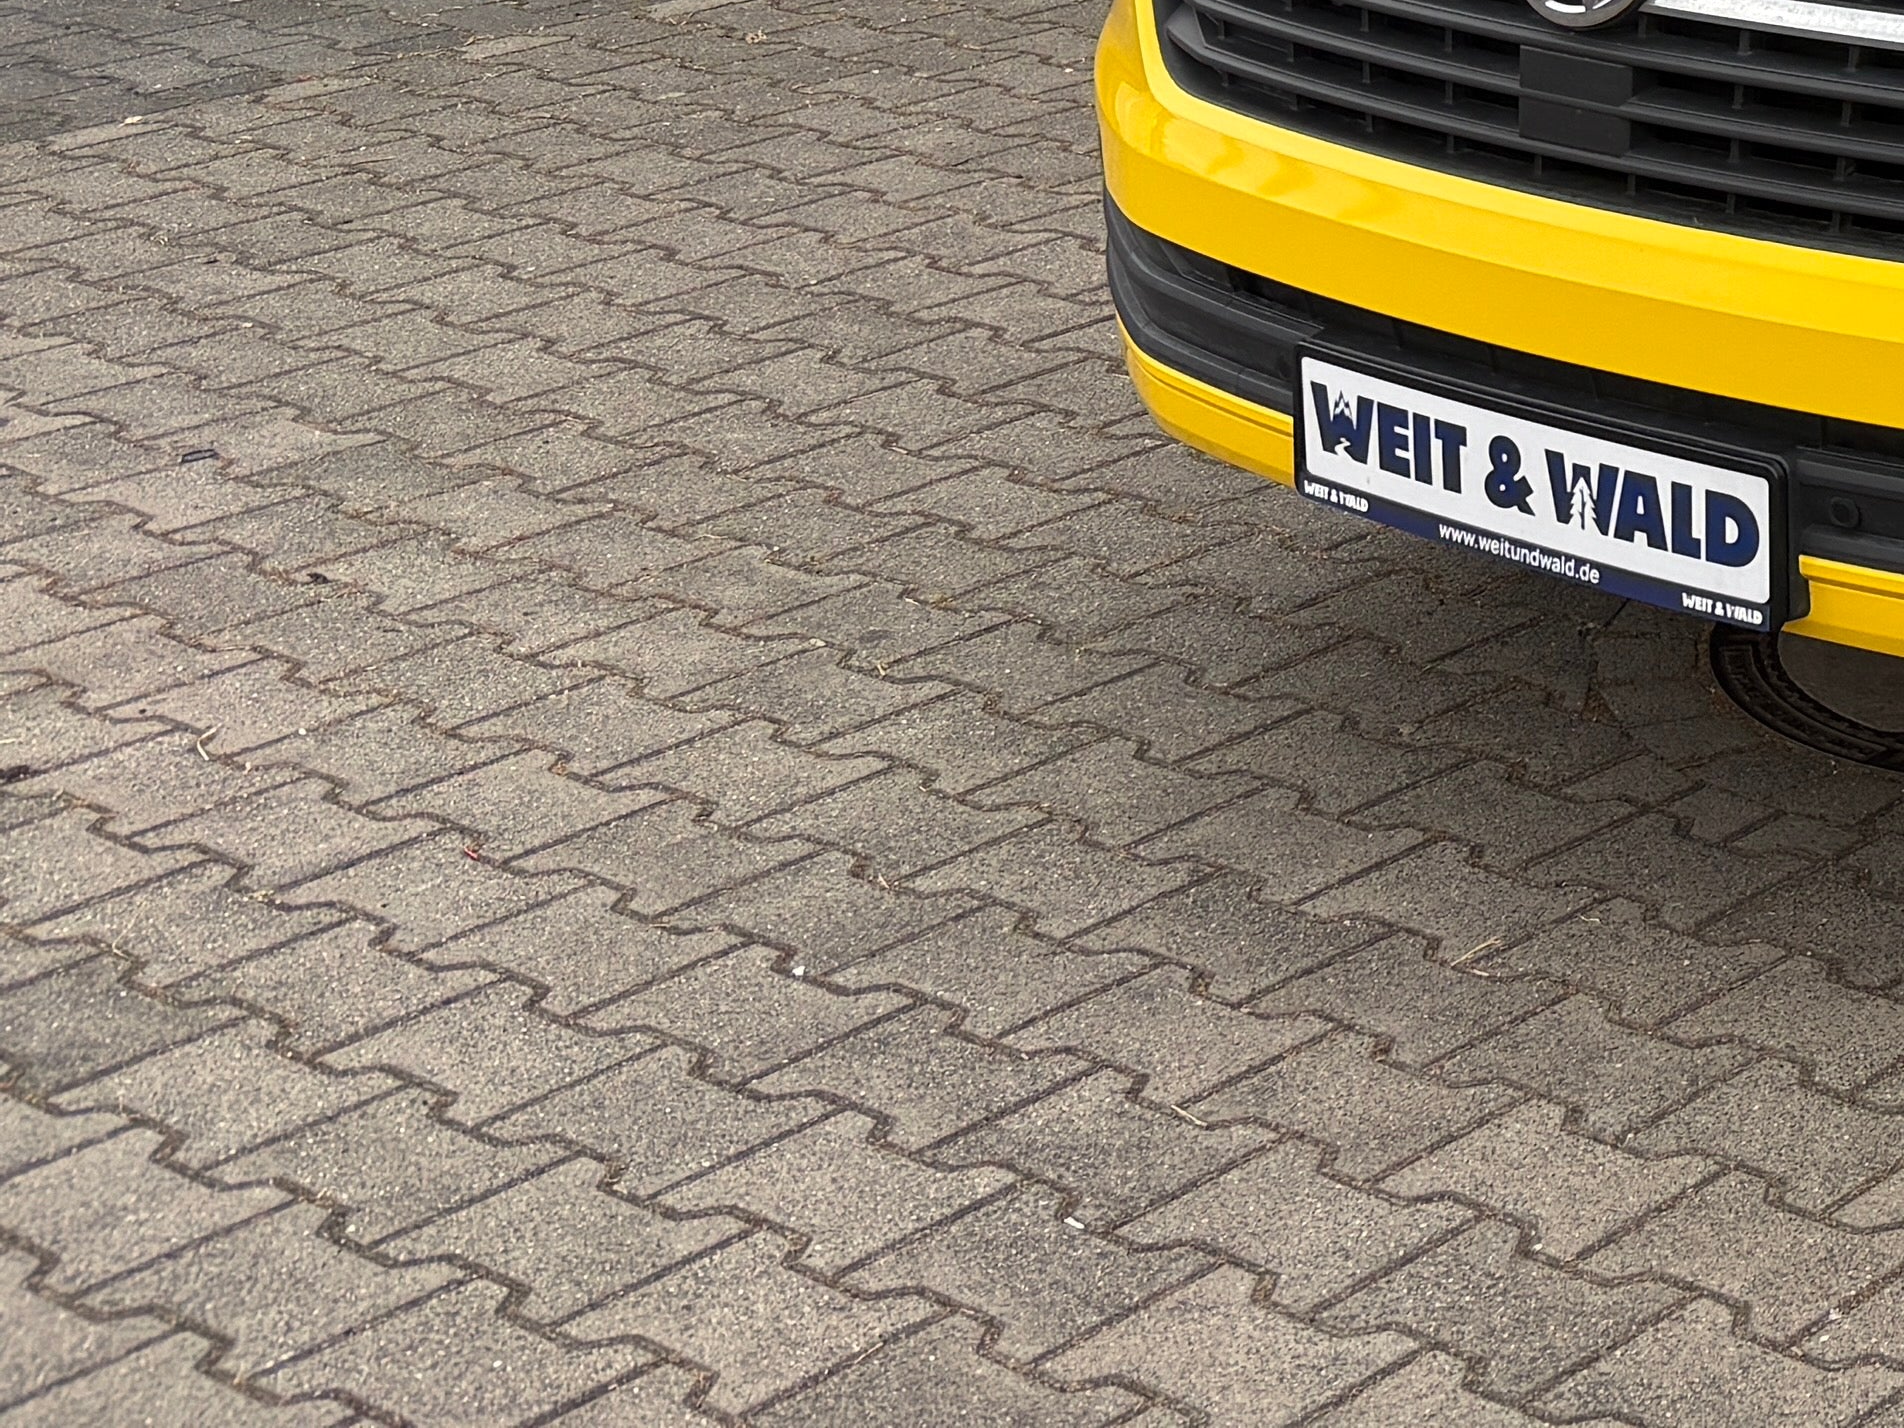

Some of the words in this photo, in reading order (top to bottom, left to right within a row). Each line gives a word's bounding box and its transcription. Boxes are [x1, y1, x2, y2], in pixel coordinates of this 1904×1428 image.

[1304, 480, 1329, 501] WEIT
[1310, 380, 1467, 494] WEIT
[1484, 434, 1535, 516] &
[1545, 448, 1760, 568] WALD
[1438, 523, 1600, 584] www.weitundwald.de
[1682, 592, 1713, 614] WEIT
[1714, 601, 1724, 617] &
